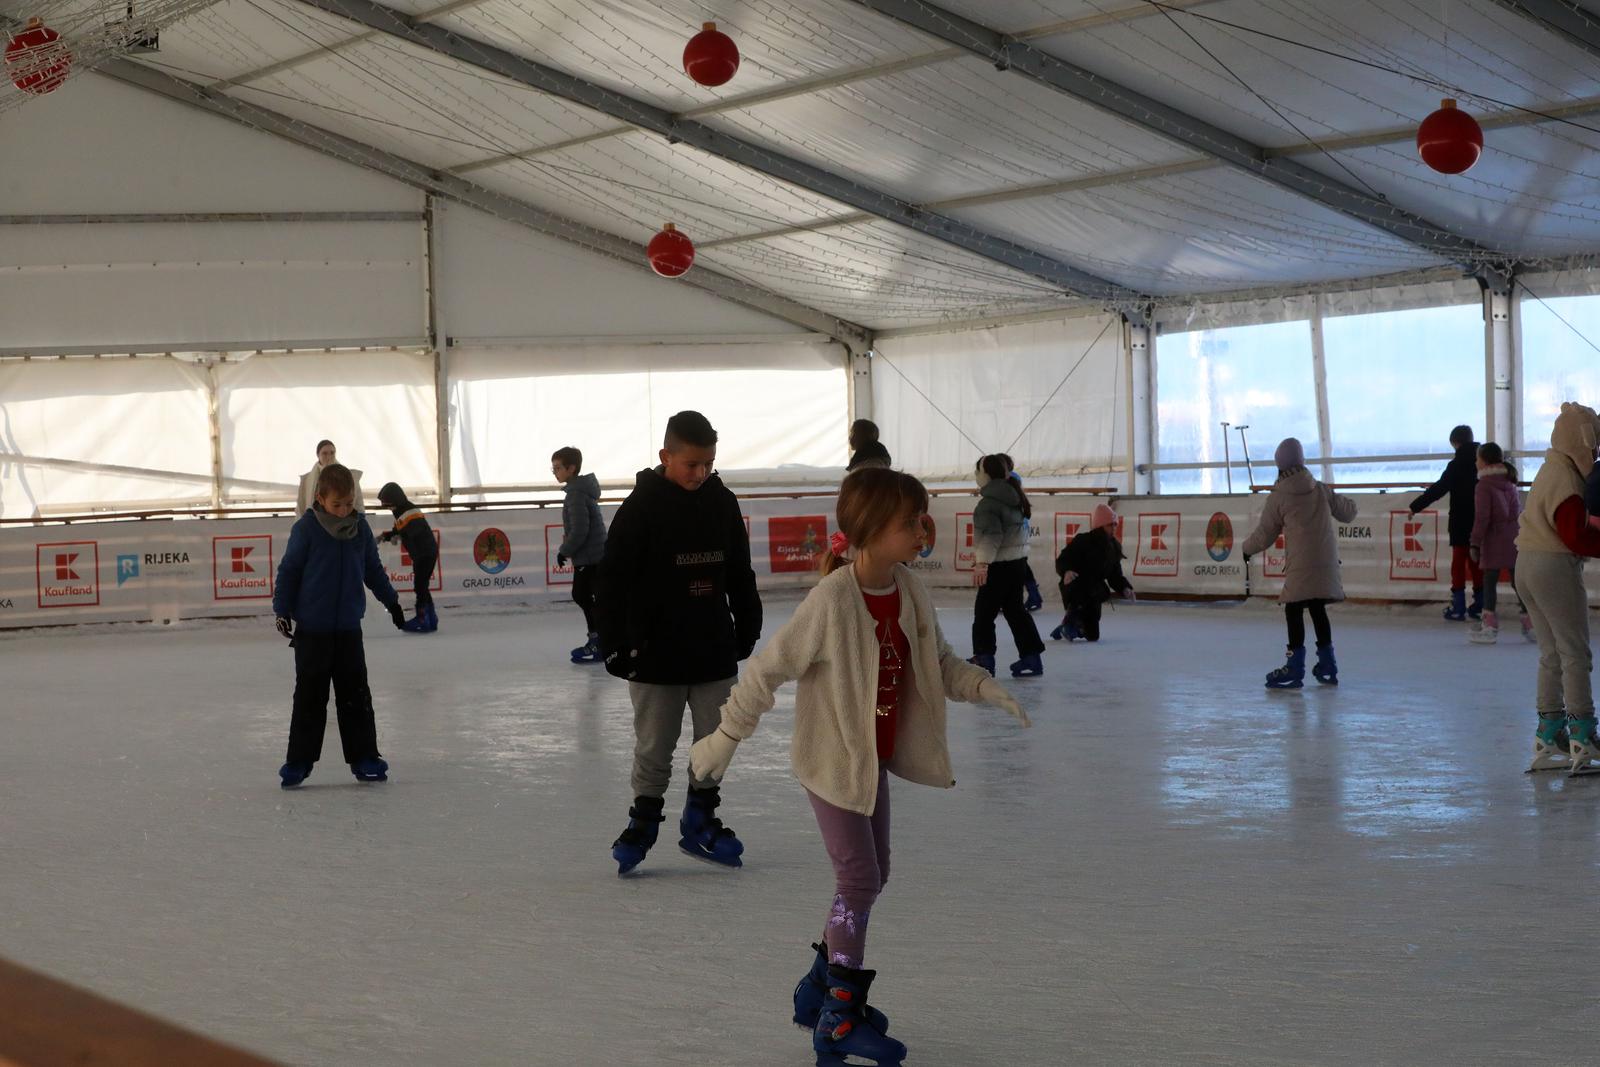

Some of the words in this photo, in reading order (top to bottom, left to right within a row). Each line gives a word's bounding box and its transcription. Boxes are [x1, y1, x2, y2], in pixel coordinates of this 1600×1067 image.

[1338, 526, 1372, 538] RIJEKA
[144, 552, 190, 565] RIJEKA
[1140, 556, 1175, 567] Kaufland
[1396, 558, 1431, 570] Kaufland
[1194, 565, 1217, 576] GRAD
[220, 579, 267, 589] Kaufland
[463, 577, 491, 588] GRAD
[494, 576, 524, 588] RIJEKA
[45, 586, 92, 597] Kaufland
